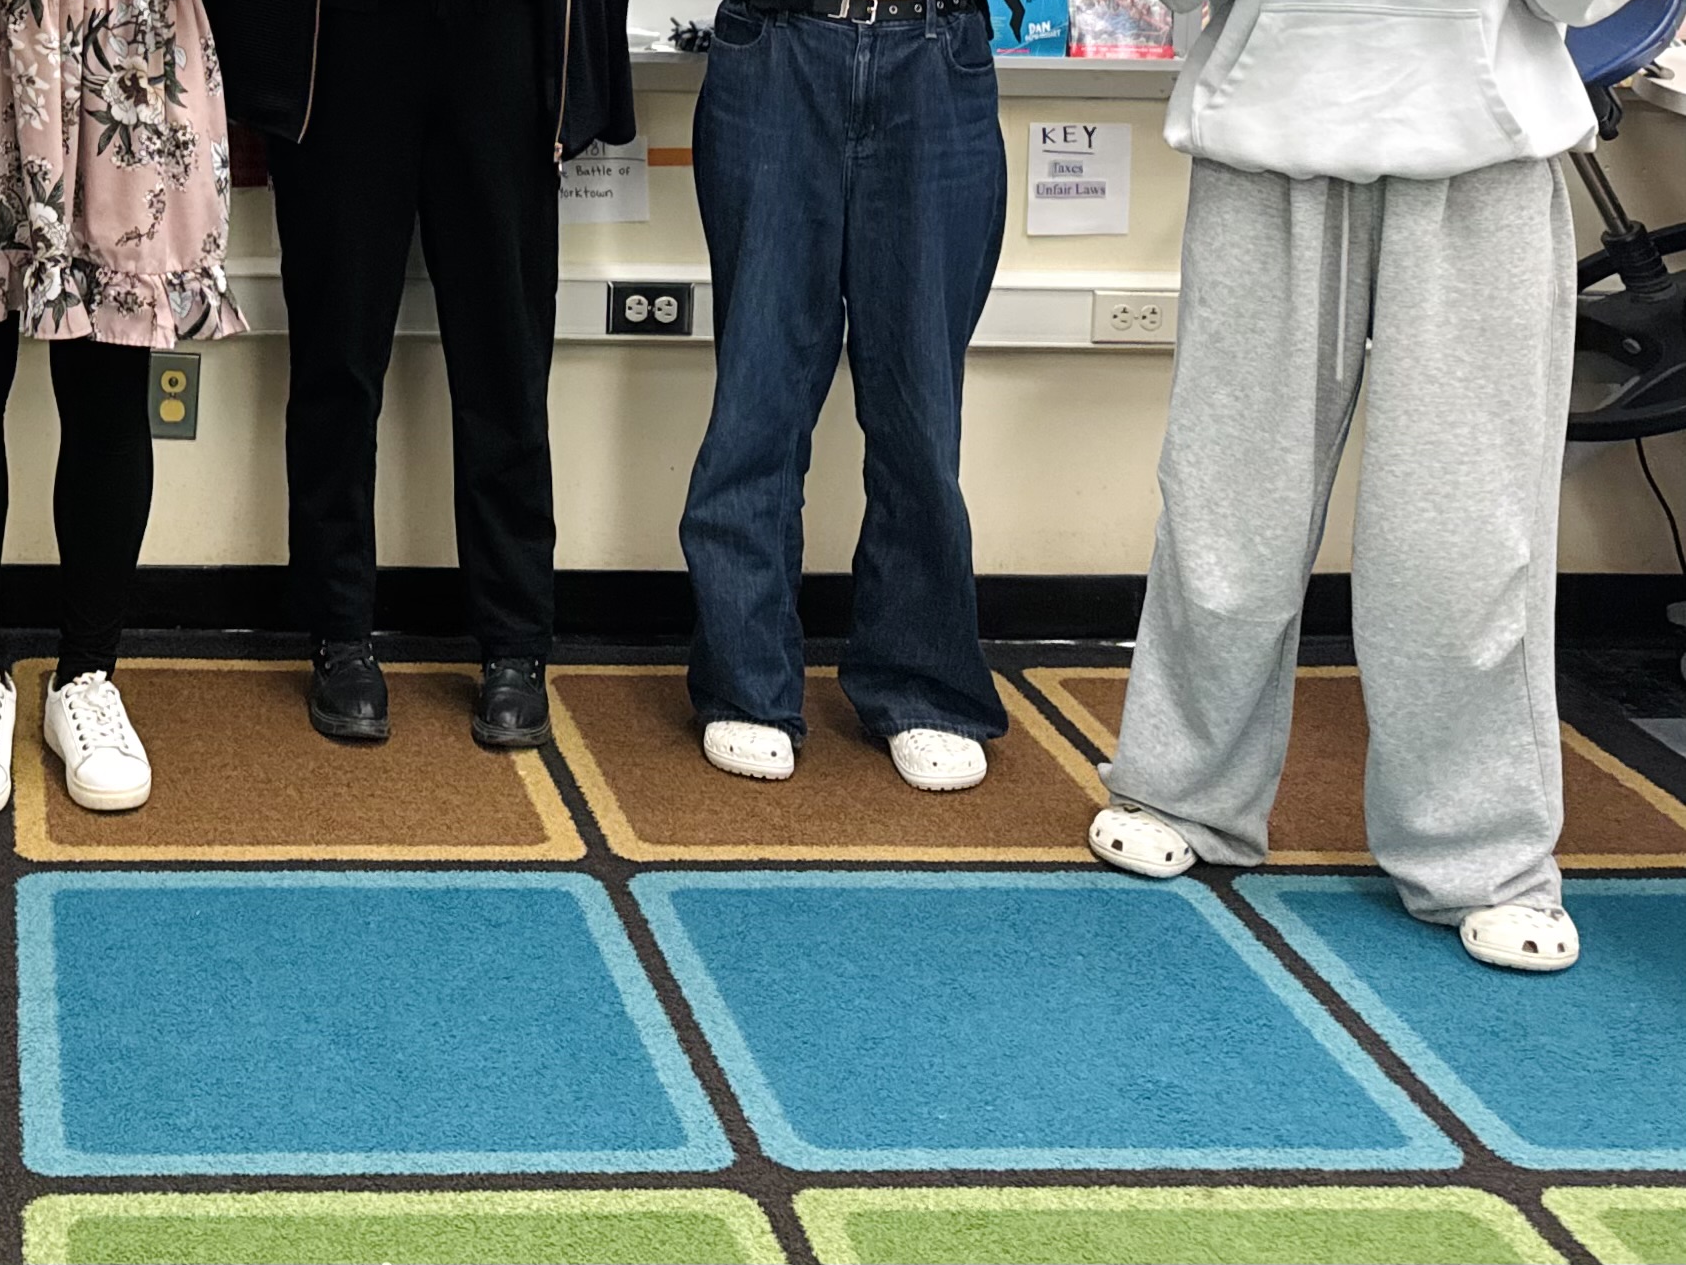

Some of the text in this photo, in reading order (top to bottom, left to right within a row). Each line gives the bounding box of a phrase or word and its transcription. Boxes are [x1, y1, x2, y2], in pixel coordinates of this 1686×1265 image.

[1029, 20, 1051, 34] DAN
[1042, 125, 1097, 149] KEY
[576, 165, 613, 177] Battle
[618, 166, 632, 176] of
[1053, 161, 1084, 175] Taxes
[1036, 184, 1106, 197] Unfair Laws
